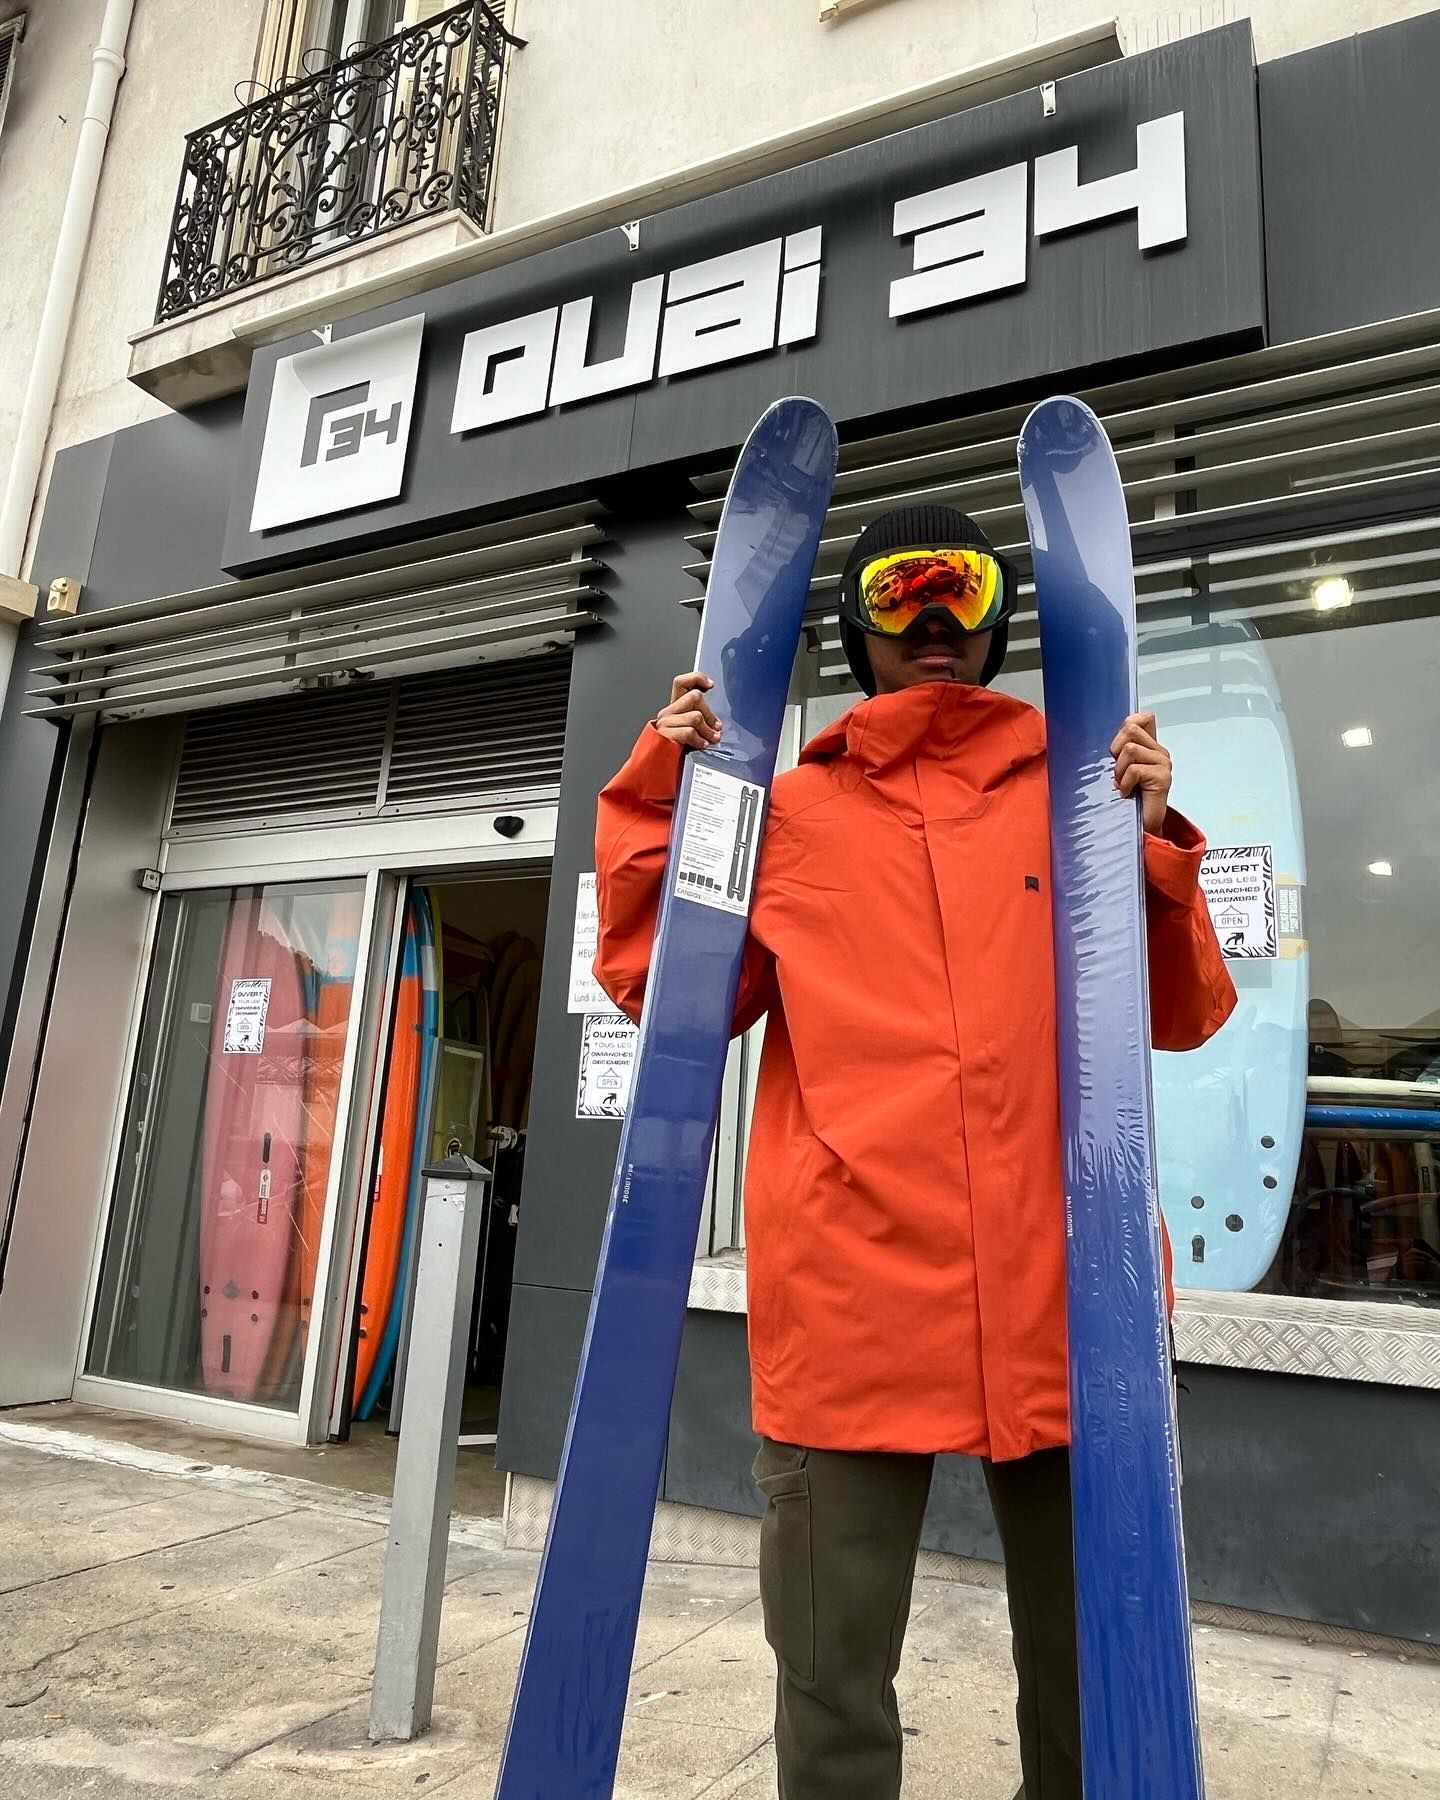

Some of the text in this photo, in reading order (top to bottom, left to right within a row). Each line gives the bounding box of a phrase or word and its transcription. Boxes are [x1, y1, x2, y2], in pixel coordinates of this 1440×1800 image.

[888, 111, 1187, 318] 34
[1200, 864, 1260, 875] OUVERT
[580, 879, 596, 889] HEU
[1205, 876, 1257, 885] TOUS LES
[1221, 917, 1243, 925] OPEN
[592, 1031, 636, 1039] OUVERT
